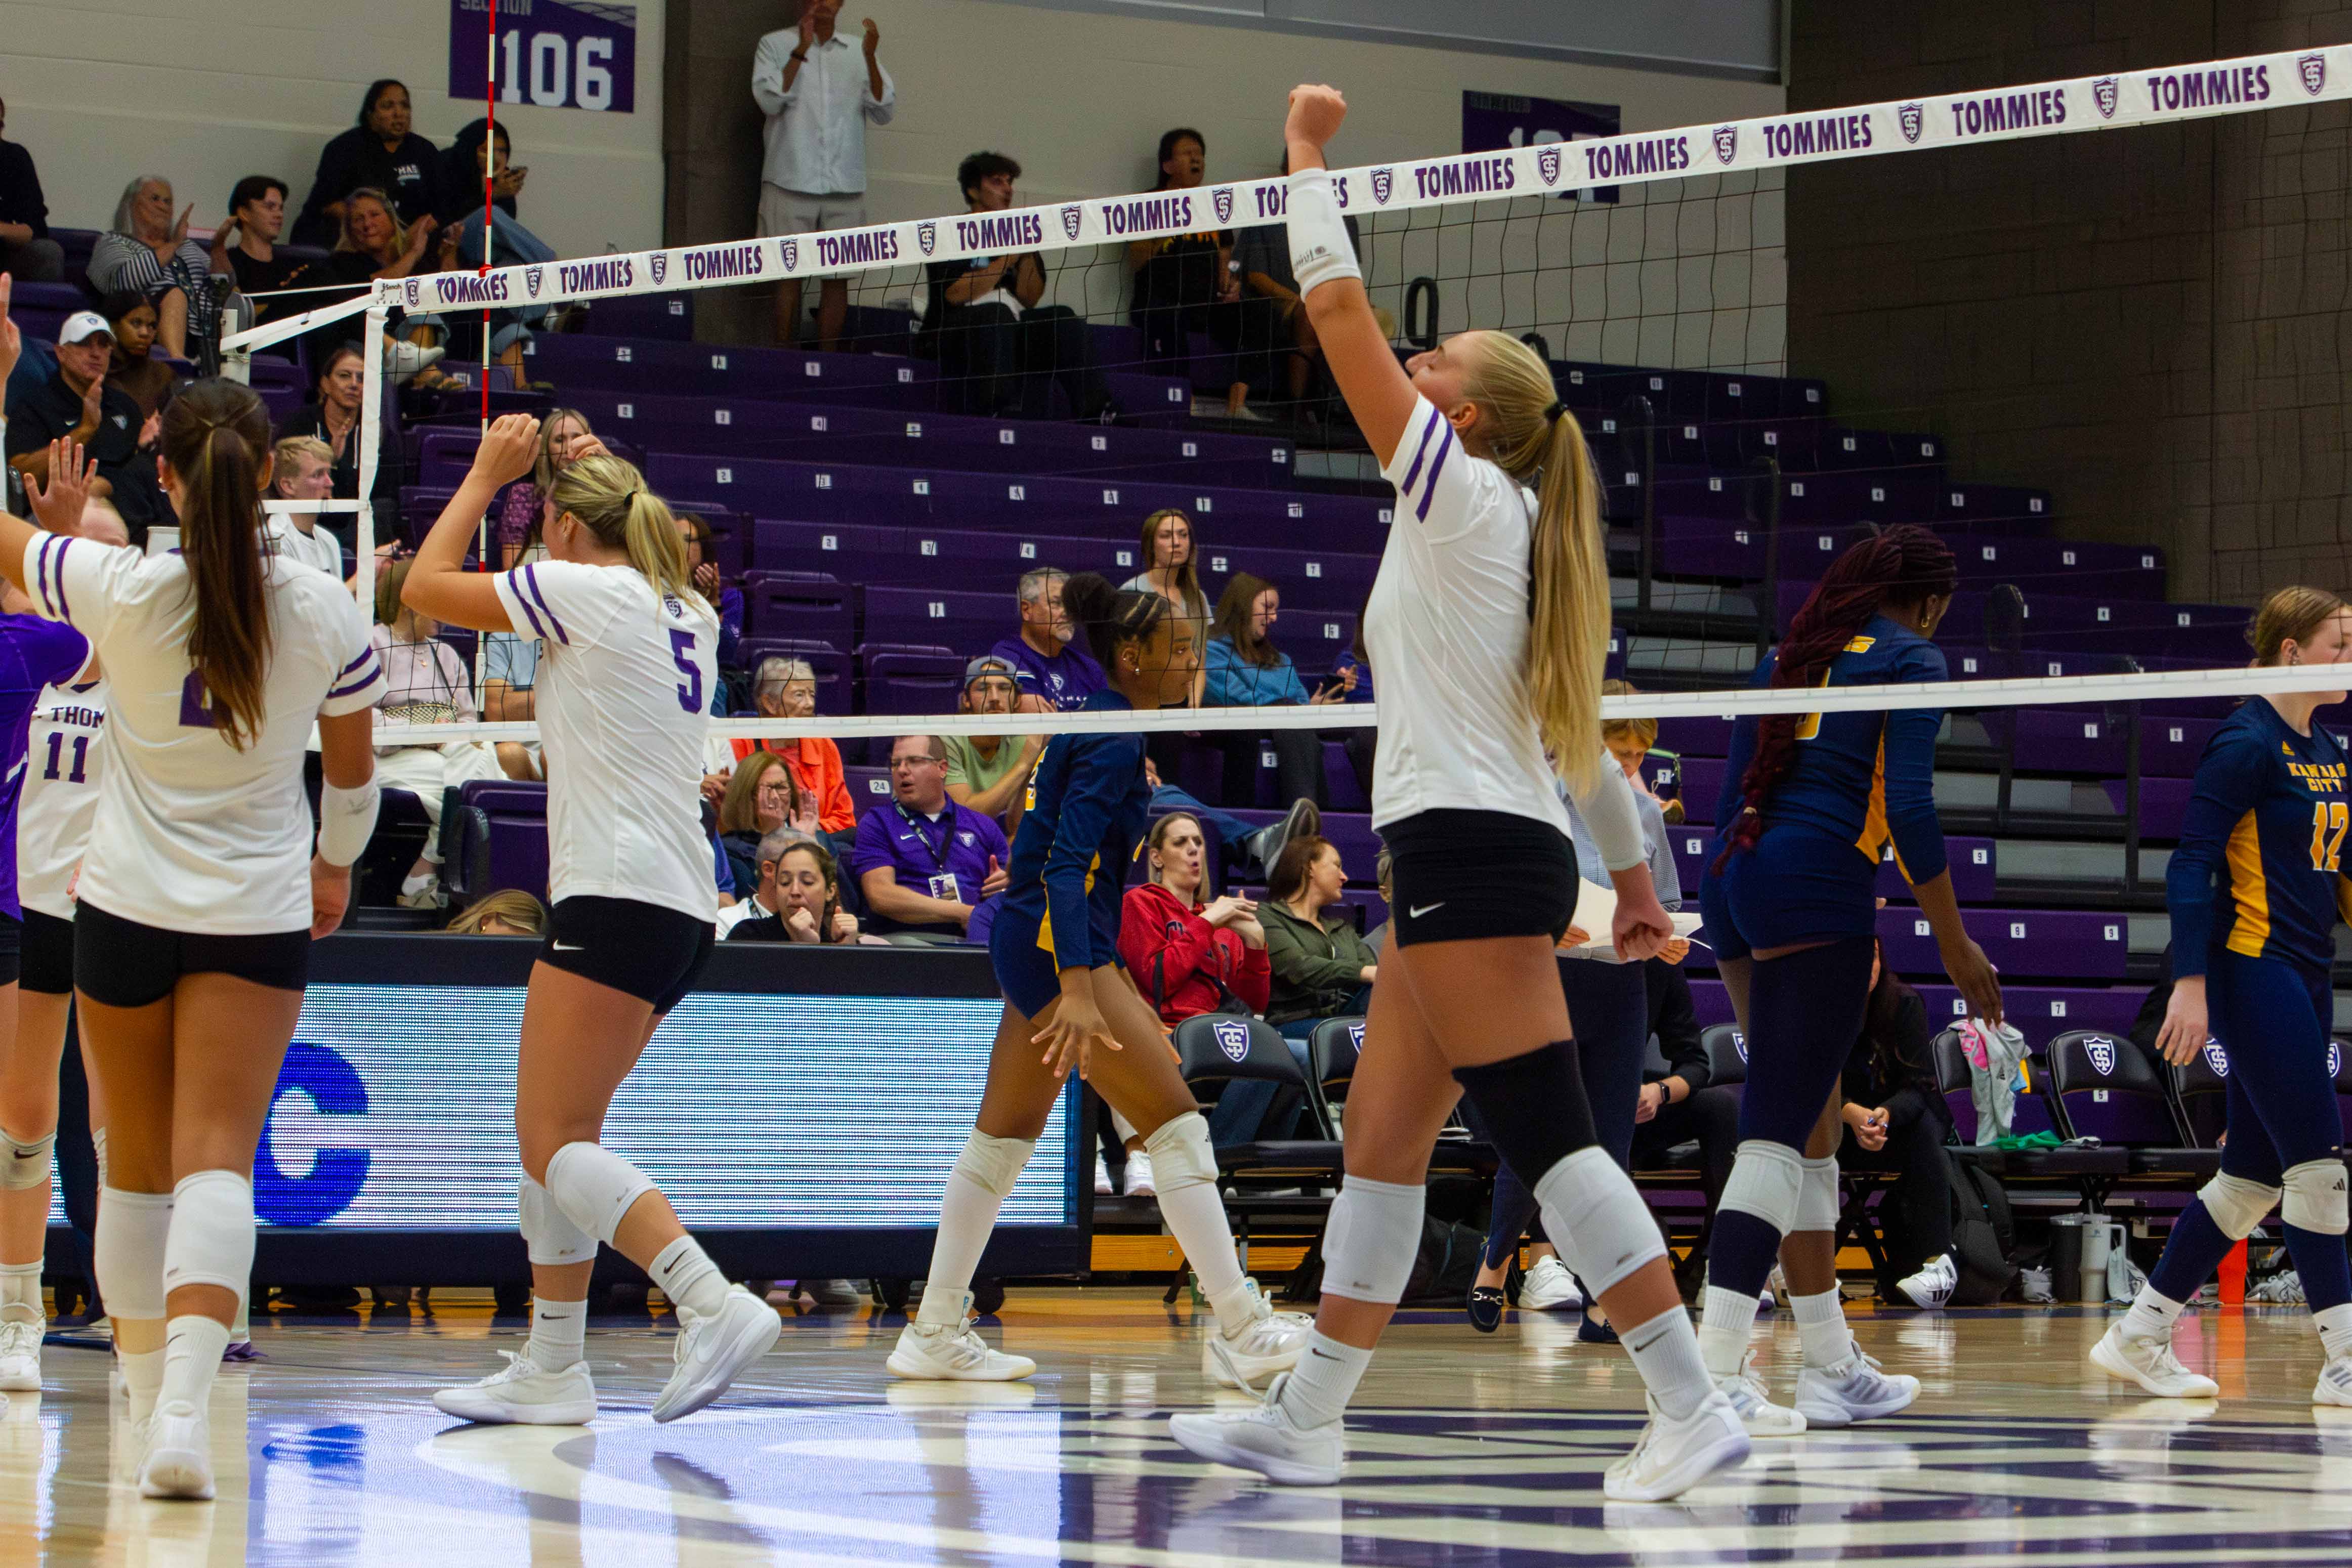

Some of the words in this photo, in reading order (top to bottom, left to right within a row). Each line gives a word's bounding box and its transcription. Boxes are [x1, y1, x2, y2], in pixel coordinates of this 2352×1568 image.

[501, 29, 612, 111] 106
[436, 274, 508, 303] TOMMIES
[561, 263, 633, 293] TOMMIES
[684, 246, 762, 281] TOMMIES
[817, 230, 898, 267] TOMMIES
[957, 214, 1042, 251] TOMMIES
[1102, 196, 1192, 236] TOMMIES
[1415, 158, 1515, 199] TOMMIES
[1585, 136, 1688, 180] TOMMIES
[1763, 114, 1872, 159] TOMMIES
[1951, 89, 2065, 136] TOMMIES
[2148, 64, 2270, 111] TOMMIES
[1096, 439, 1101, 448] 7
[722, 471, 726, 481] 2
[821, 478, 825, 486] 3
[826, 538, 831, 547] 2
[1312, 566, 1316, 575] 7
[1968, 661, 1971, 670] 1
[668, 628, 702, 714] 5
[2089, 726, 2092, 737] 1
[44, 732, 89, 784] 11
[2286, 762, 2347, 777] KANSAS
[1662, 772, 1666, 782] 7
[874, 781, 885, 791] 24
[2306, 778, 2343, 792] CITY
[2309, 801, 2349, 872] 12
[1691, 842, 1697, 852] 6
[1978, 852, 1982, 862] 9
[1919, 923, 1924, 933] 7
[2015, 926, 2020, 936] 8
[2109, 928, 2114, 938] 9
[2055, 1003, 2061, 1014] 7
